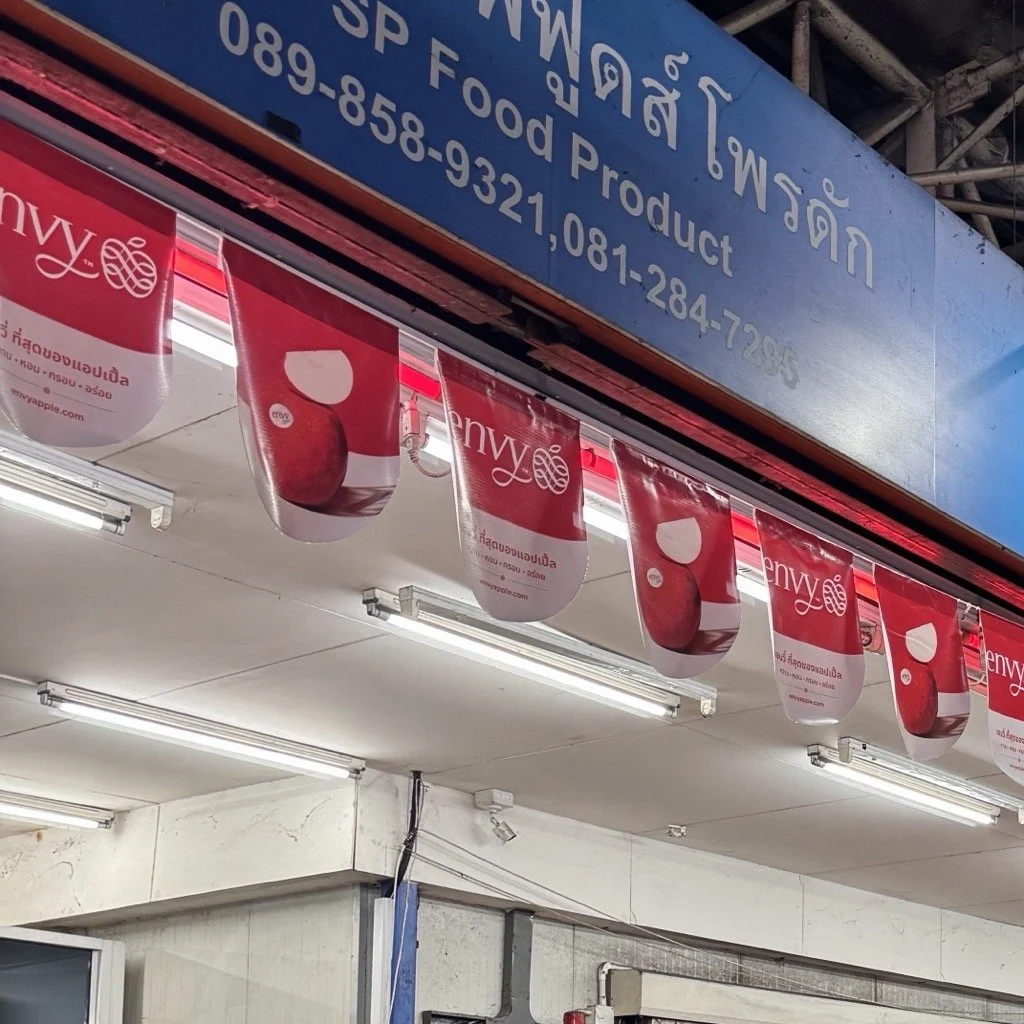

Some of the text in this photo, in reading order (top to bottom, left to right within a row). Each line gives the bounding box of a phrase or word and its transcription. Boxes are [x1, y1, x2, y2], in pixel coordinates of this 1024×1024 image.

[332, 0, 733, 278] SP Food Product
[698, 76, 874, 289] โพรดัก
[0, 186, 100, 280] nvy
[10, 387, 86, 422] envyapple.com
[447, 409, 533, 488] envy
[763, 555, 821, 616] envy
